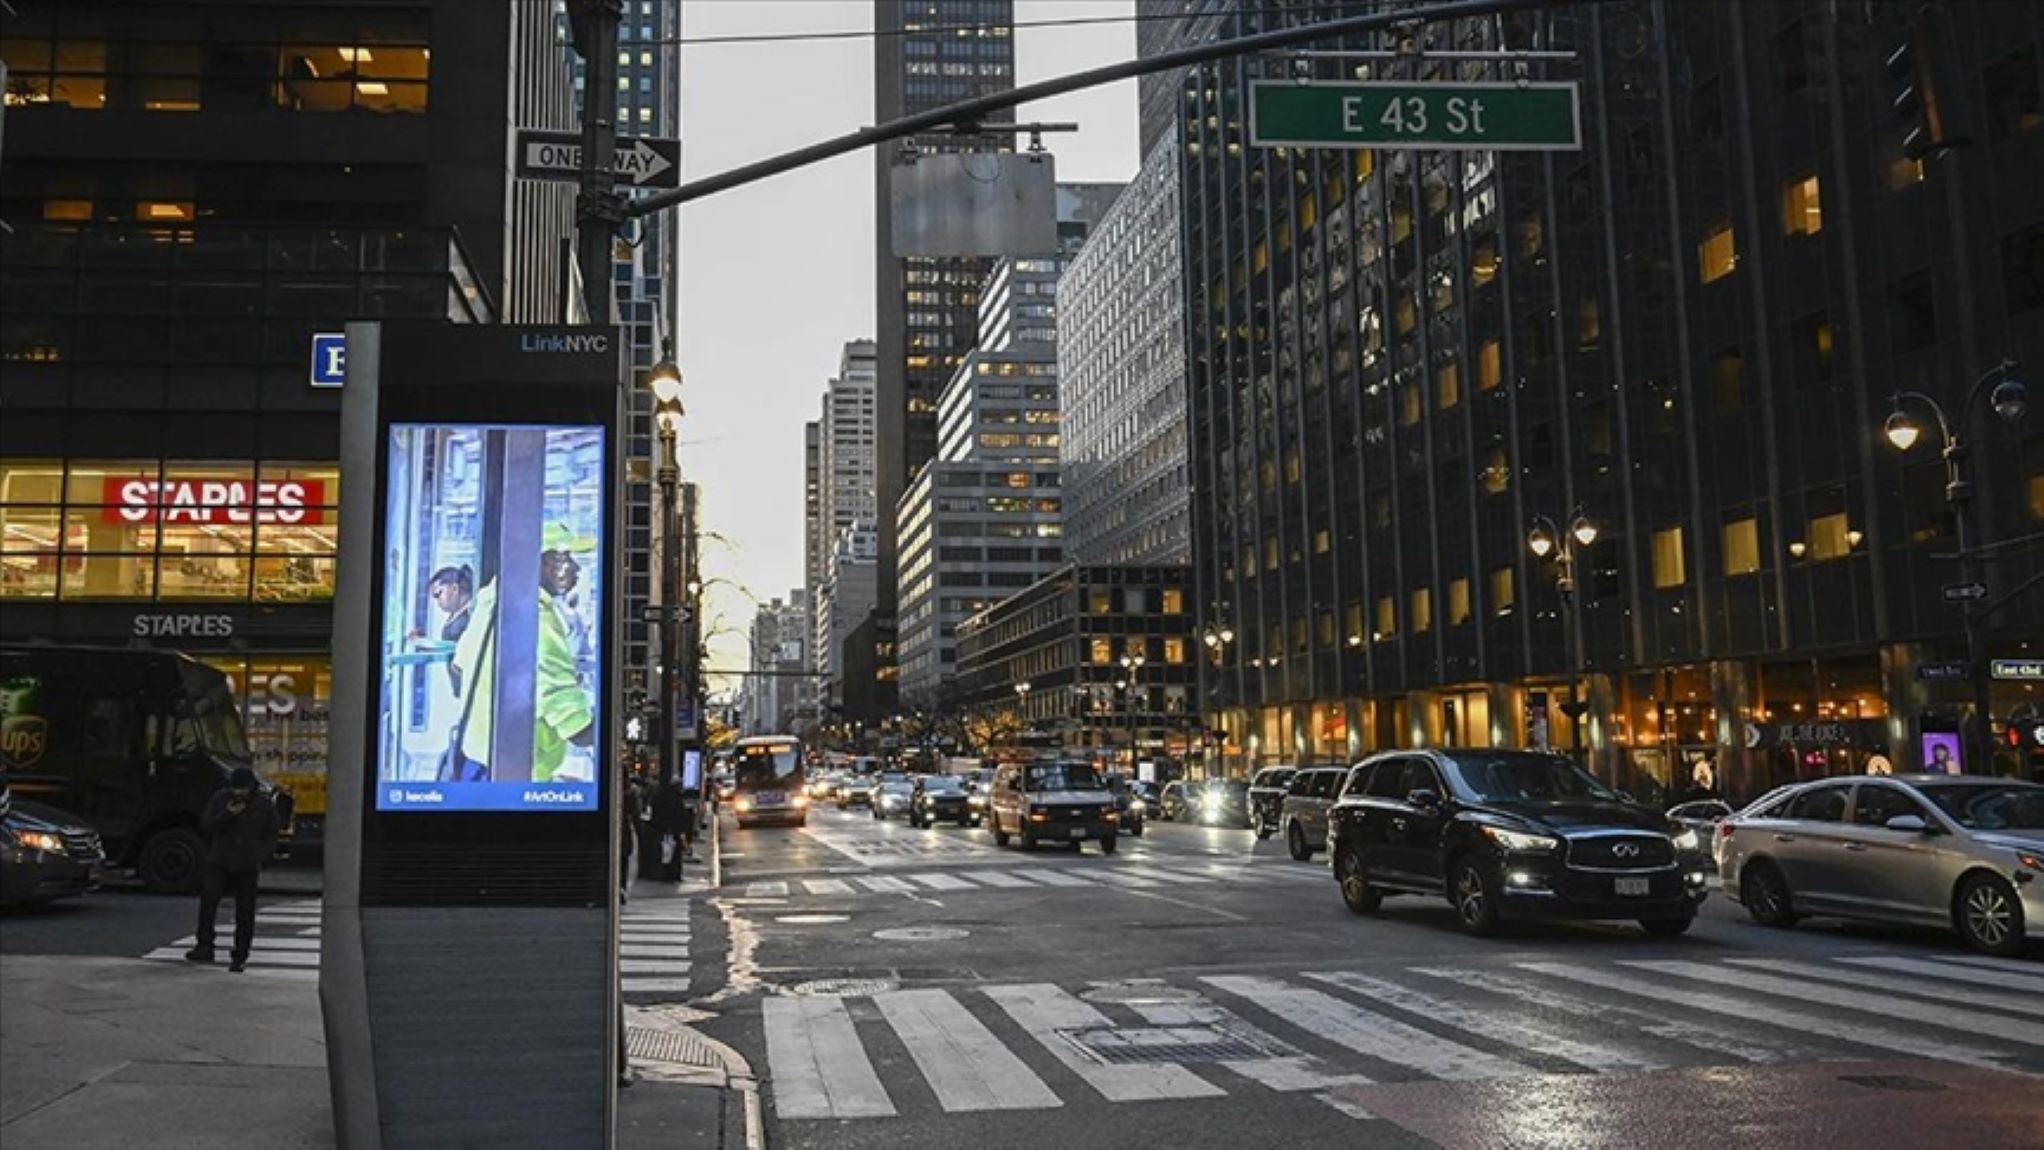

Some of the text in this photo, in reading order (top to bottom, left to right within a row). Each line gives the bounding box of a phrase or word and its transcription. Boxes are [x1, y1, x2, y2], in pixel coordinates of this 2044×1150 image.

[1342, 96, 1485, 133] E 43 St
[521, 334, 608, 352] LinkNYC
[119, 481, 306, 523] STAPLES
[133, 614, 233, 636] STAPLES
